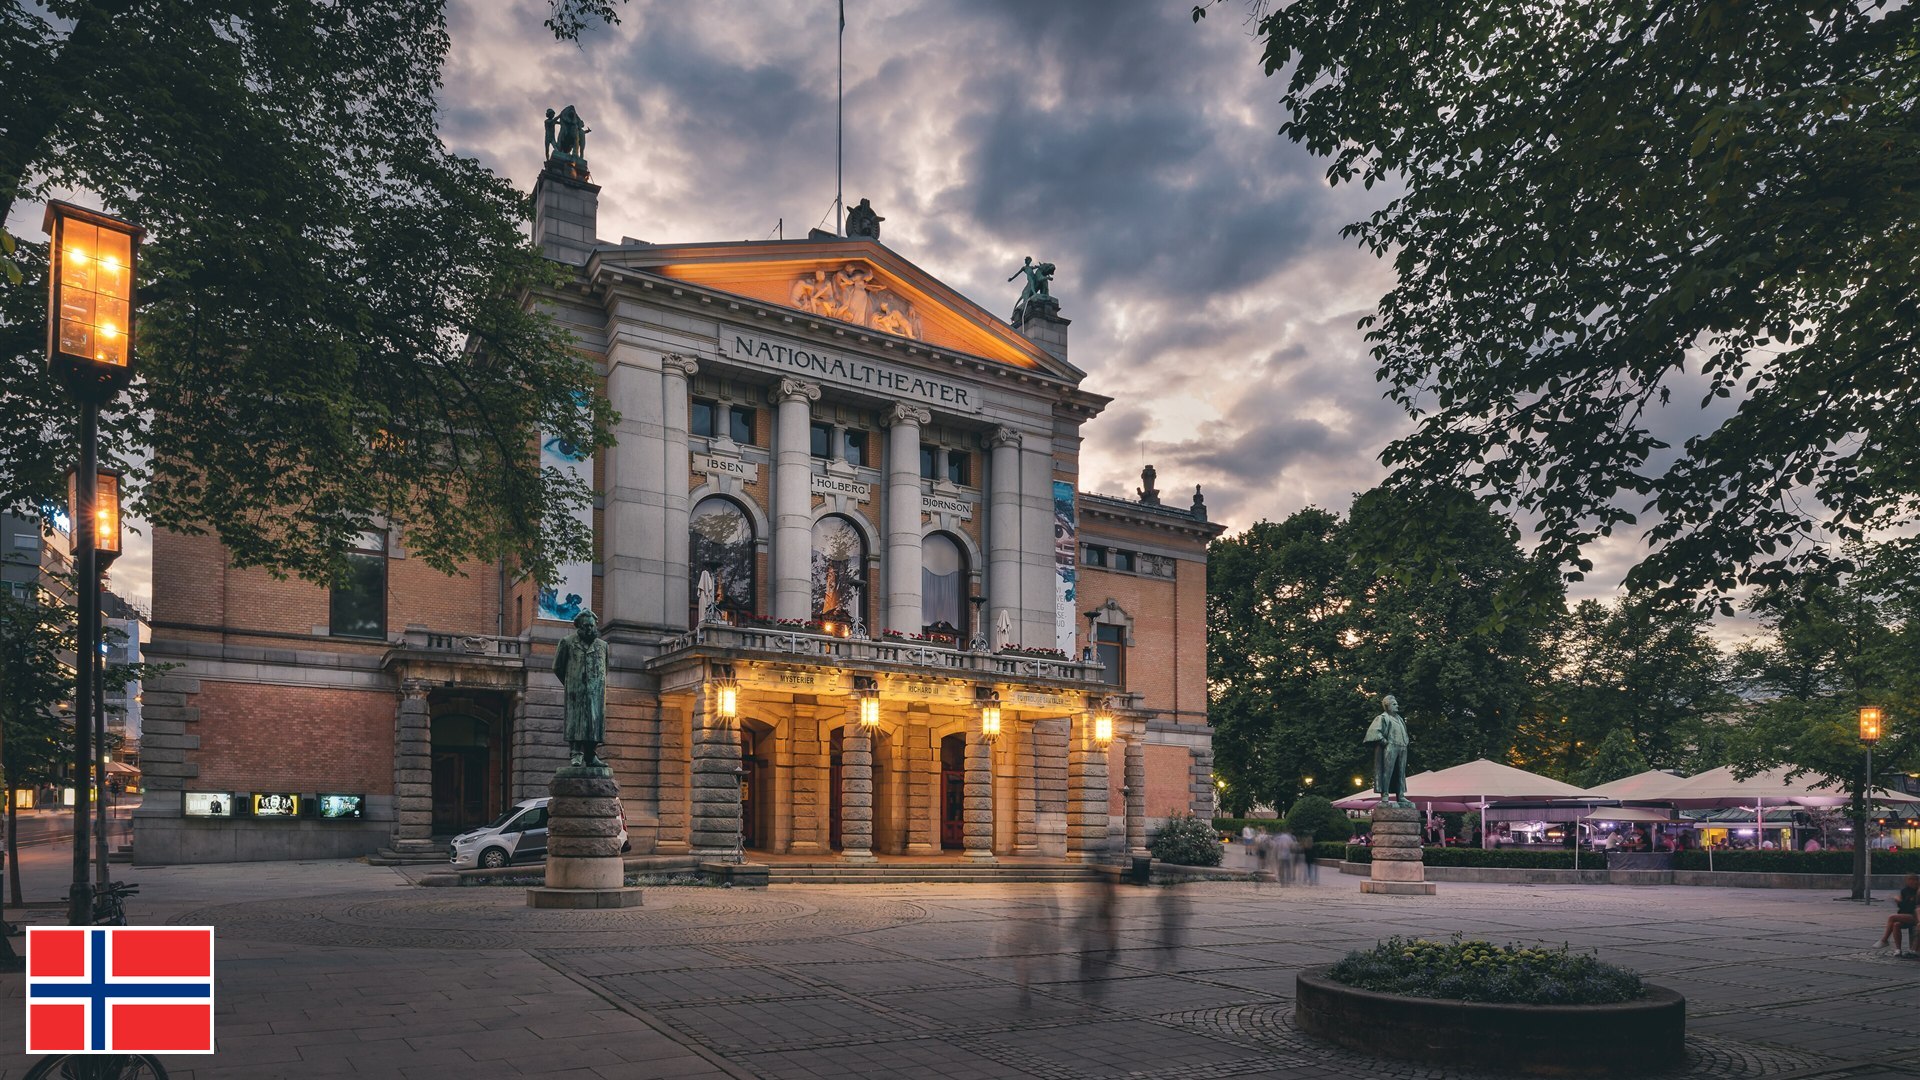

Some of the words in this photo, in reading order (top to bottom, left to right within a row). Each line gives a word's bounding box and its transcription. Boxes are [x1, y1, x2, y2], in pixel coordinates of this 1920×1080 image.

[736, 336, 968, 405] NATIONALTHEATER
[706, 459, 744, 474] IBSEN
[816, 478, 866, 495] HOLBERG
[780, 674, 815, 684] MYSTERIER
[908, 685, 932, 694] RICHARD
